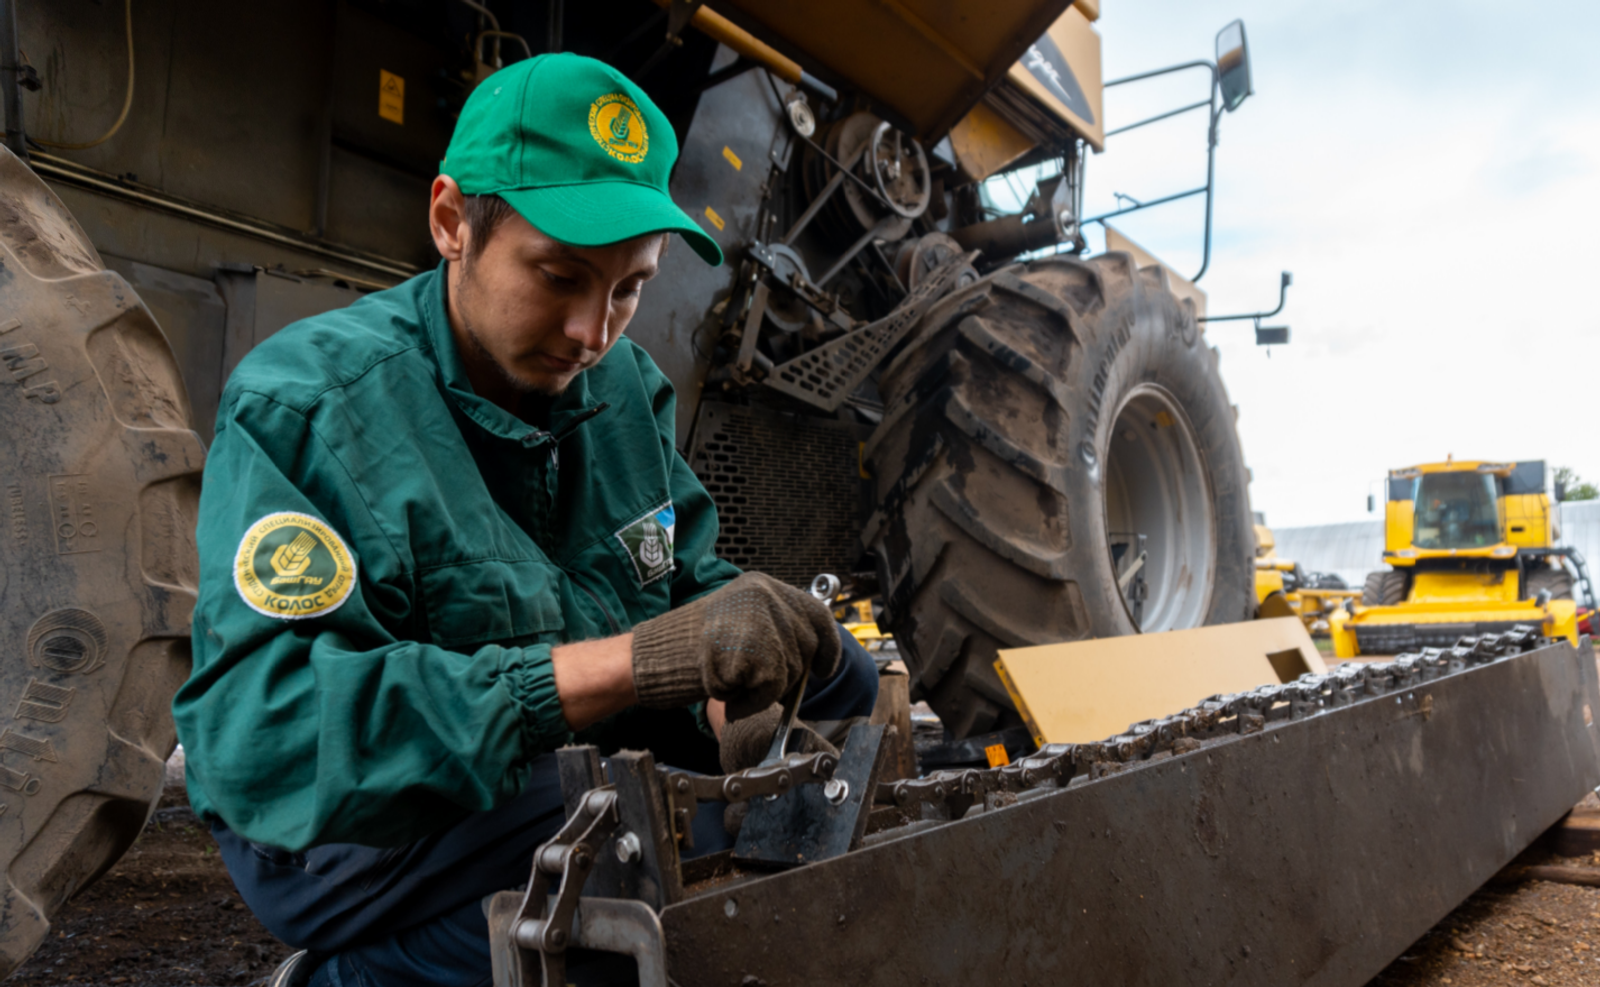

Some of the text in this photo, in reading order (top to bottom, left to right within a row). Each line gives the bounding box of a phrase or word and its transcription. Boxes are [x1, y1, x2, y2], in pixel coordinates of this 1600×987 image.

[243, 517, 350, 599] СТУДЕНЧЕСКИЙ СПЕЦИАЛИЗИРОВАННЫЙ ОТРЯД
[264, 595, 325, 611] КОЛОС
